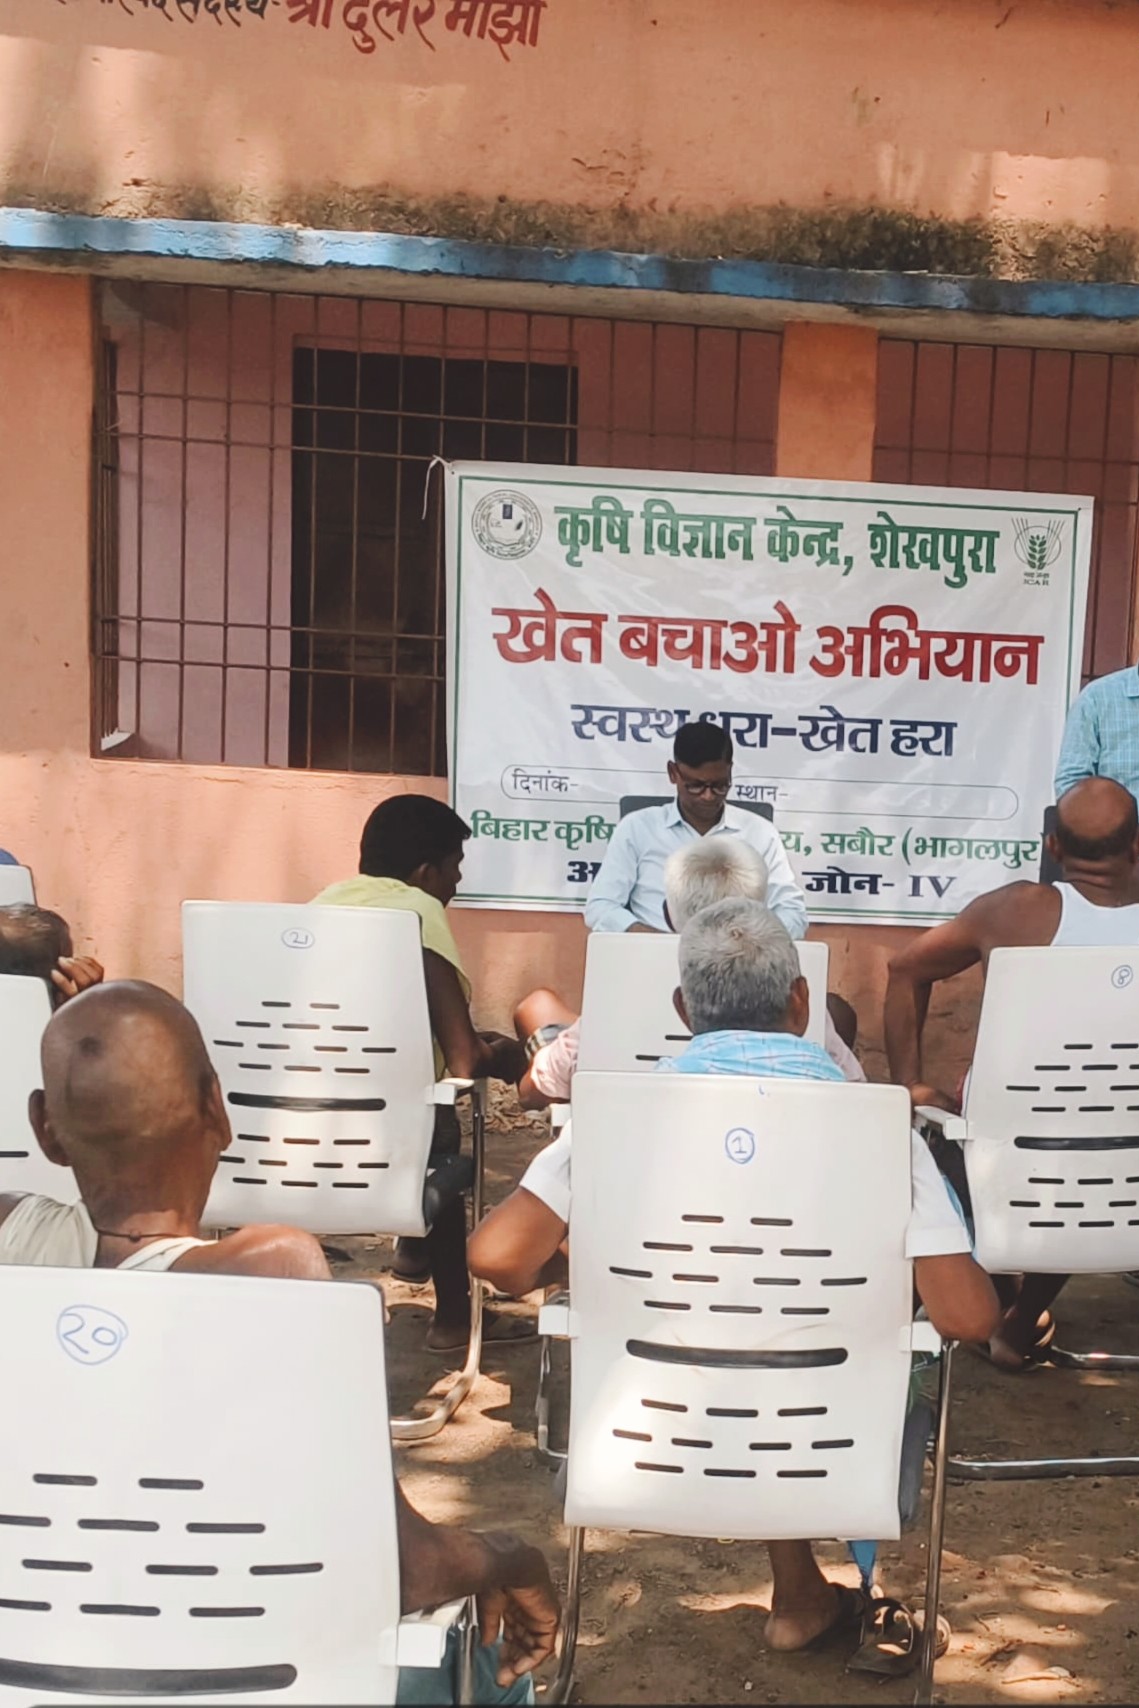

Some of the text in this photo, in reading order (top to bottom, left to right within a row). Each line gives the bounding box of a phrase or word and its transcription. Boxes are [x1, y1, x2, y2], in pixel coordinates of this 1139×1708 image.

[554, 495, 634, 567] कृषि
[640, 498, 757, 561] विज्ञान
[764, 505, 854, 576] केन्द्र,
[868, 511, 1001, 589] शेखपुरा
[491, 588, 1044, 685] खेत बचाओ अभियान
[890, 719, 958, 757] हरा
[470, 809, 617, 850] बिहार कृषि
[820, 826, 896, 857] सबौर
[901, 827, 1043, 869] (भागलपुर
[908, 875, 958, 898] IV
